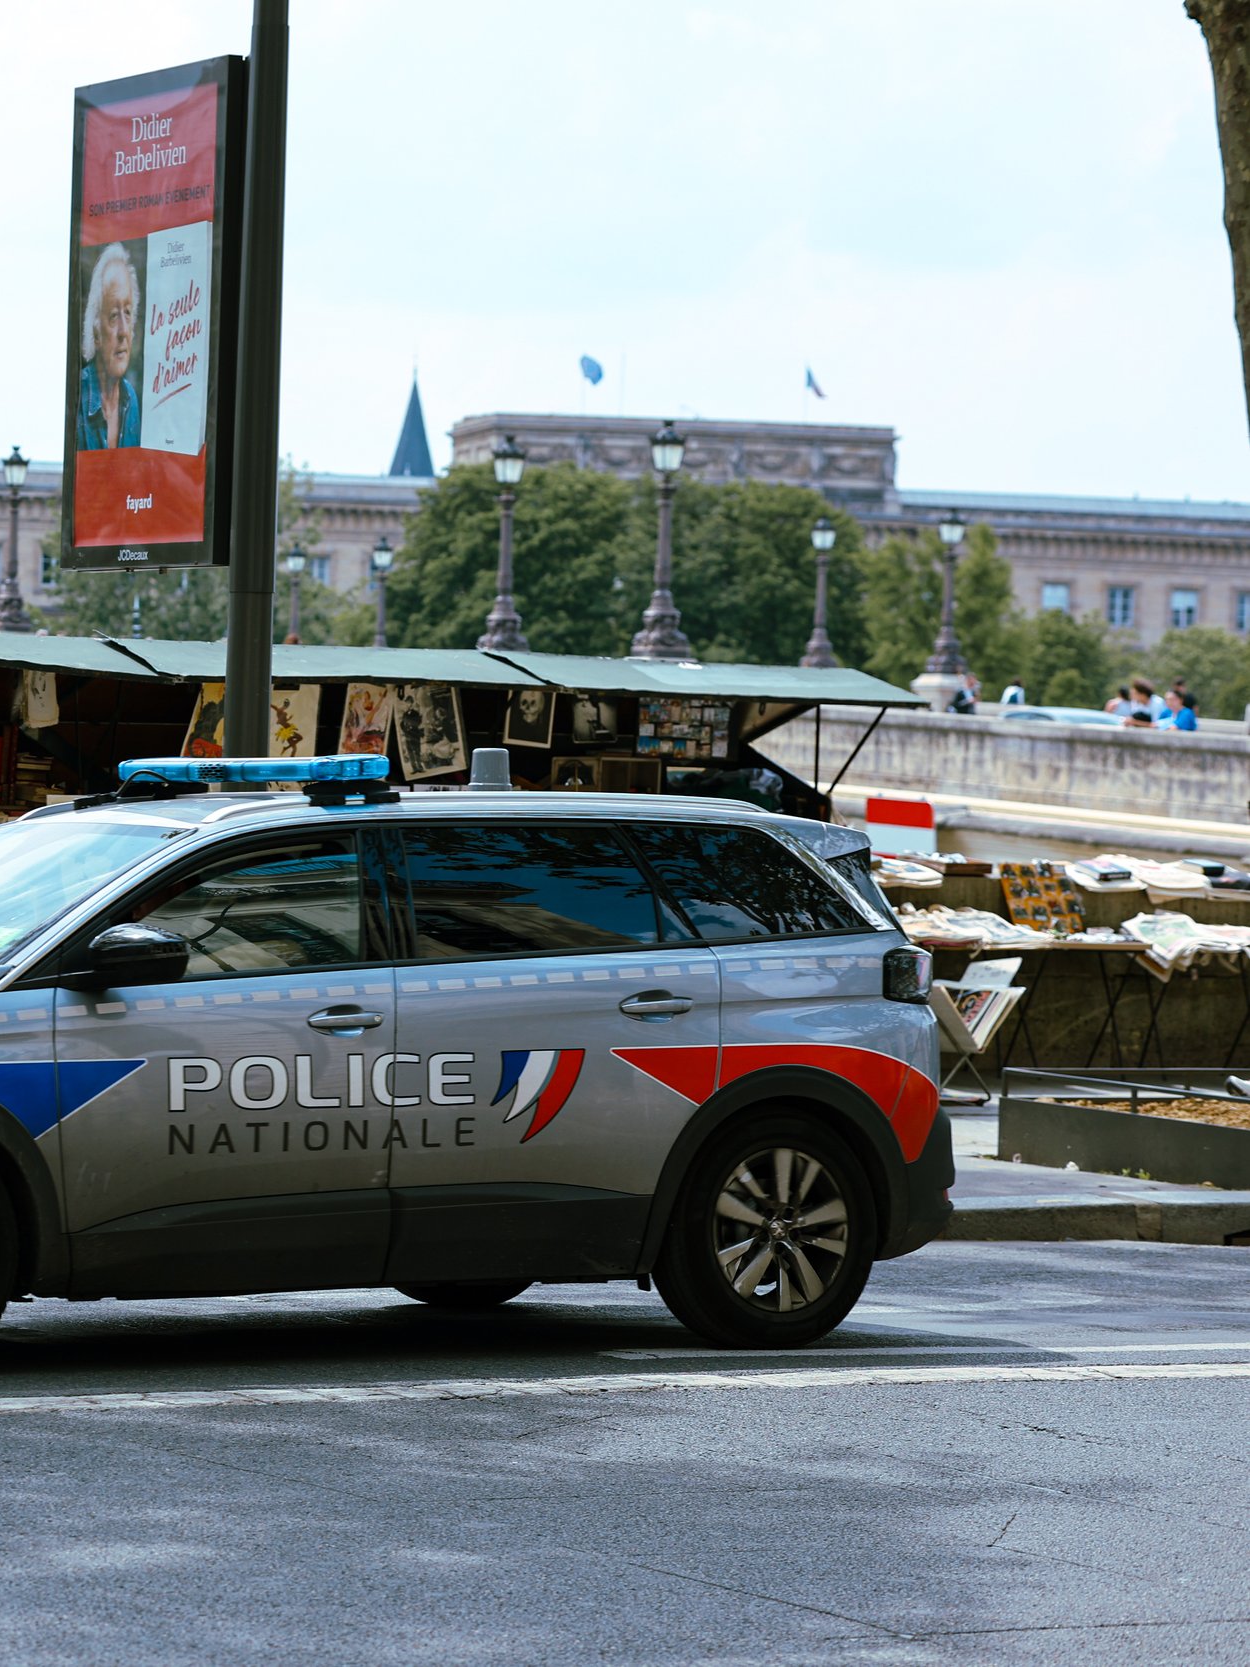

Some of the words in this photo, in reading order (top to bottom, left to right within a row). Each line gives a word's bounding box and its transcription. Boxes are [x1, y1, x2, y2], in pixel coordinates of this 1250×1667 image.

[131, 112, 173, 143] Didier
[114, 142, 187, 177] Barbelivien
[89, 203, 105, 217] SON
[105, 196, 138, 214] PREMIER
[138, 193, 164, 209] ROMAN
[160, 254, 192, 269] Barbelivien
[167, 241, 185, 254] Didier
[168, 279, 200, 325] seule
[165, 319, 202, 361] façon
[152, 352, 198, 394] d'aimer
[126, 493, 153, 514] fayard
[117, 549, 149, 562] JCDecaux
[167, 1052, 476, 1113] POLICE
[167, 1117, 476, 1156] NATIONALE
